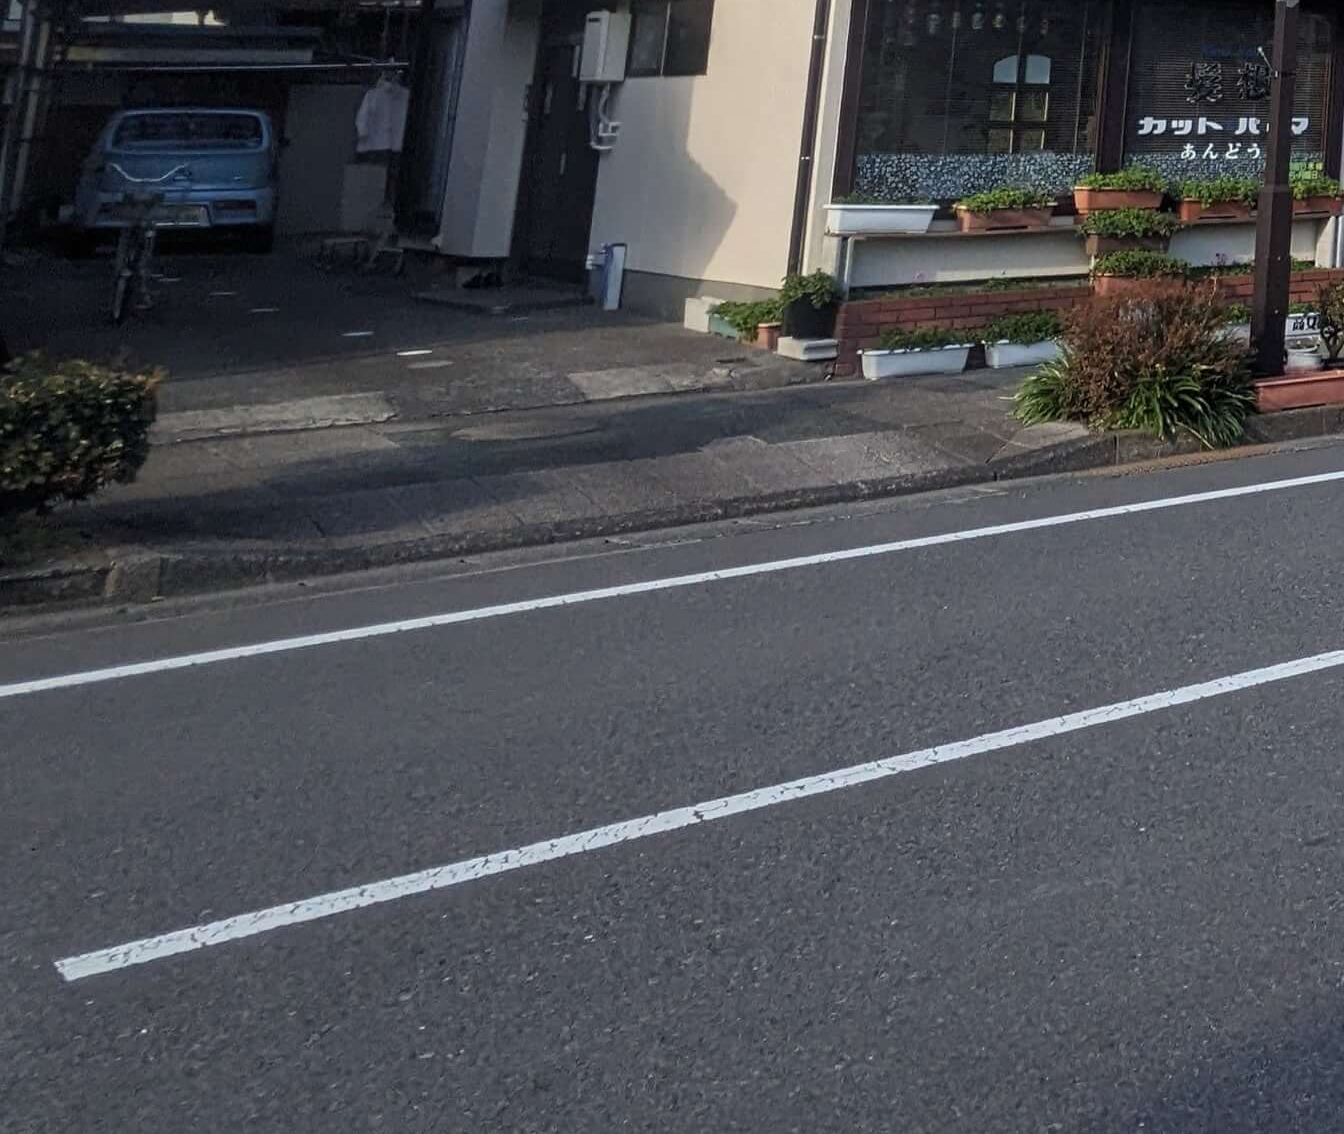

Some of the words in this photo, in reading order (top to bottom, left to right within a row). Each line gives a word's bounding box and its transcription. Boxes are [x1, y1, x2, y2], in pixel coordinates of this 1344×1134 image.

[1138, 117, 1223, 135] カット
[1234, 117, 1309, 135] パマ
[1180, 143, 1261, 160] あんどう
